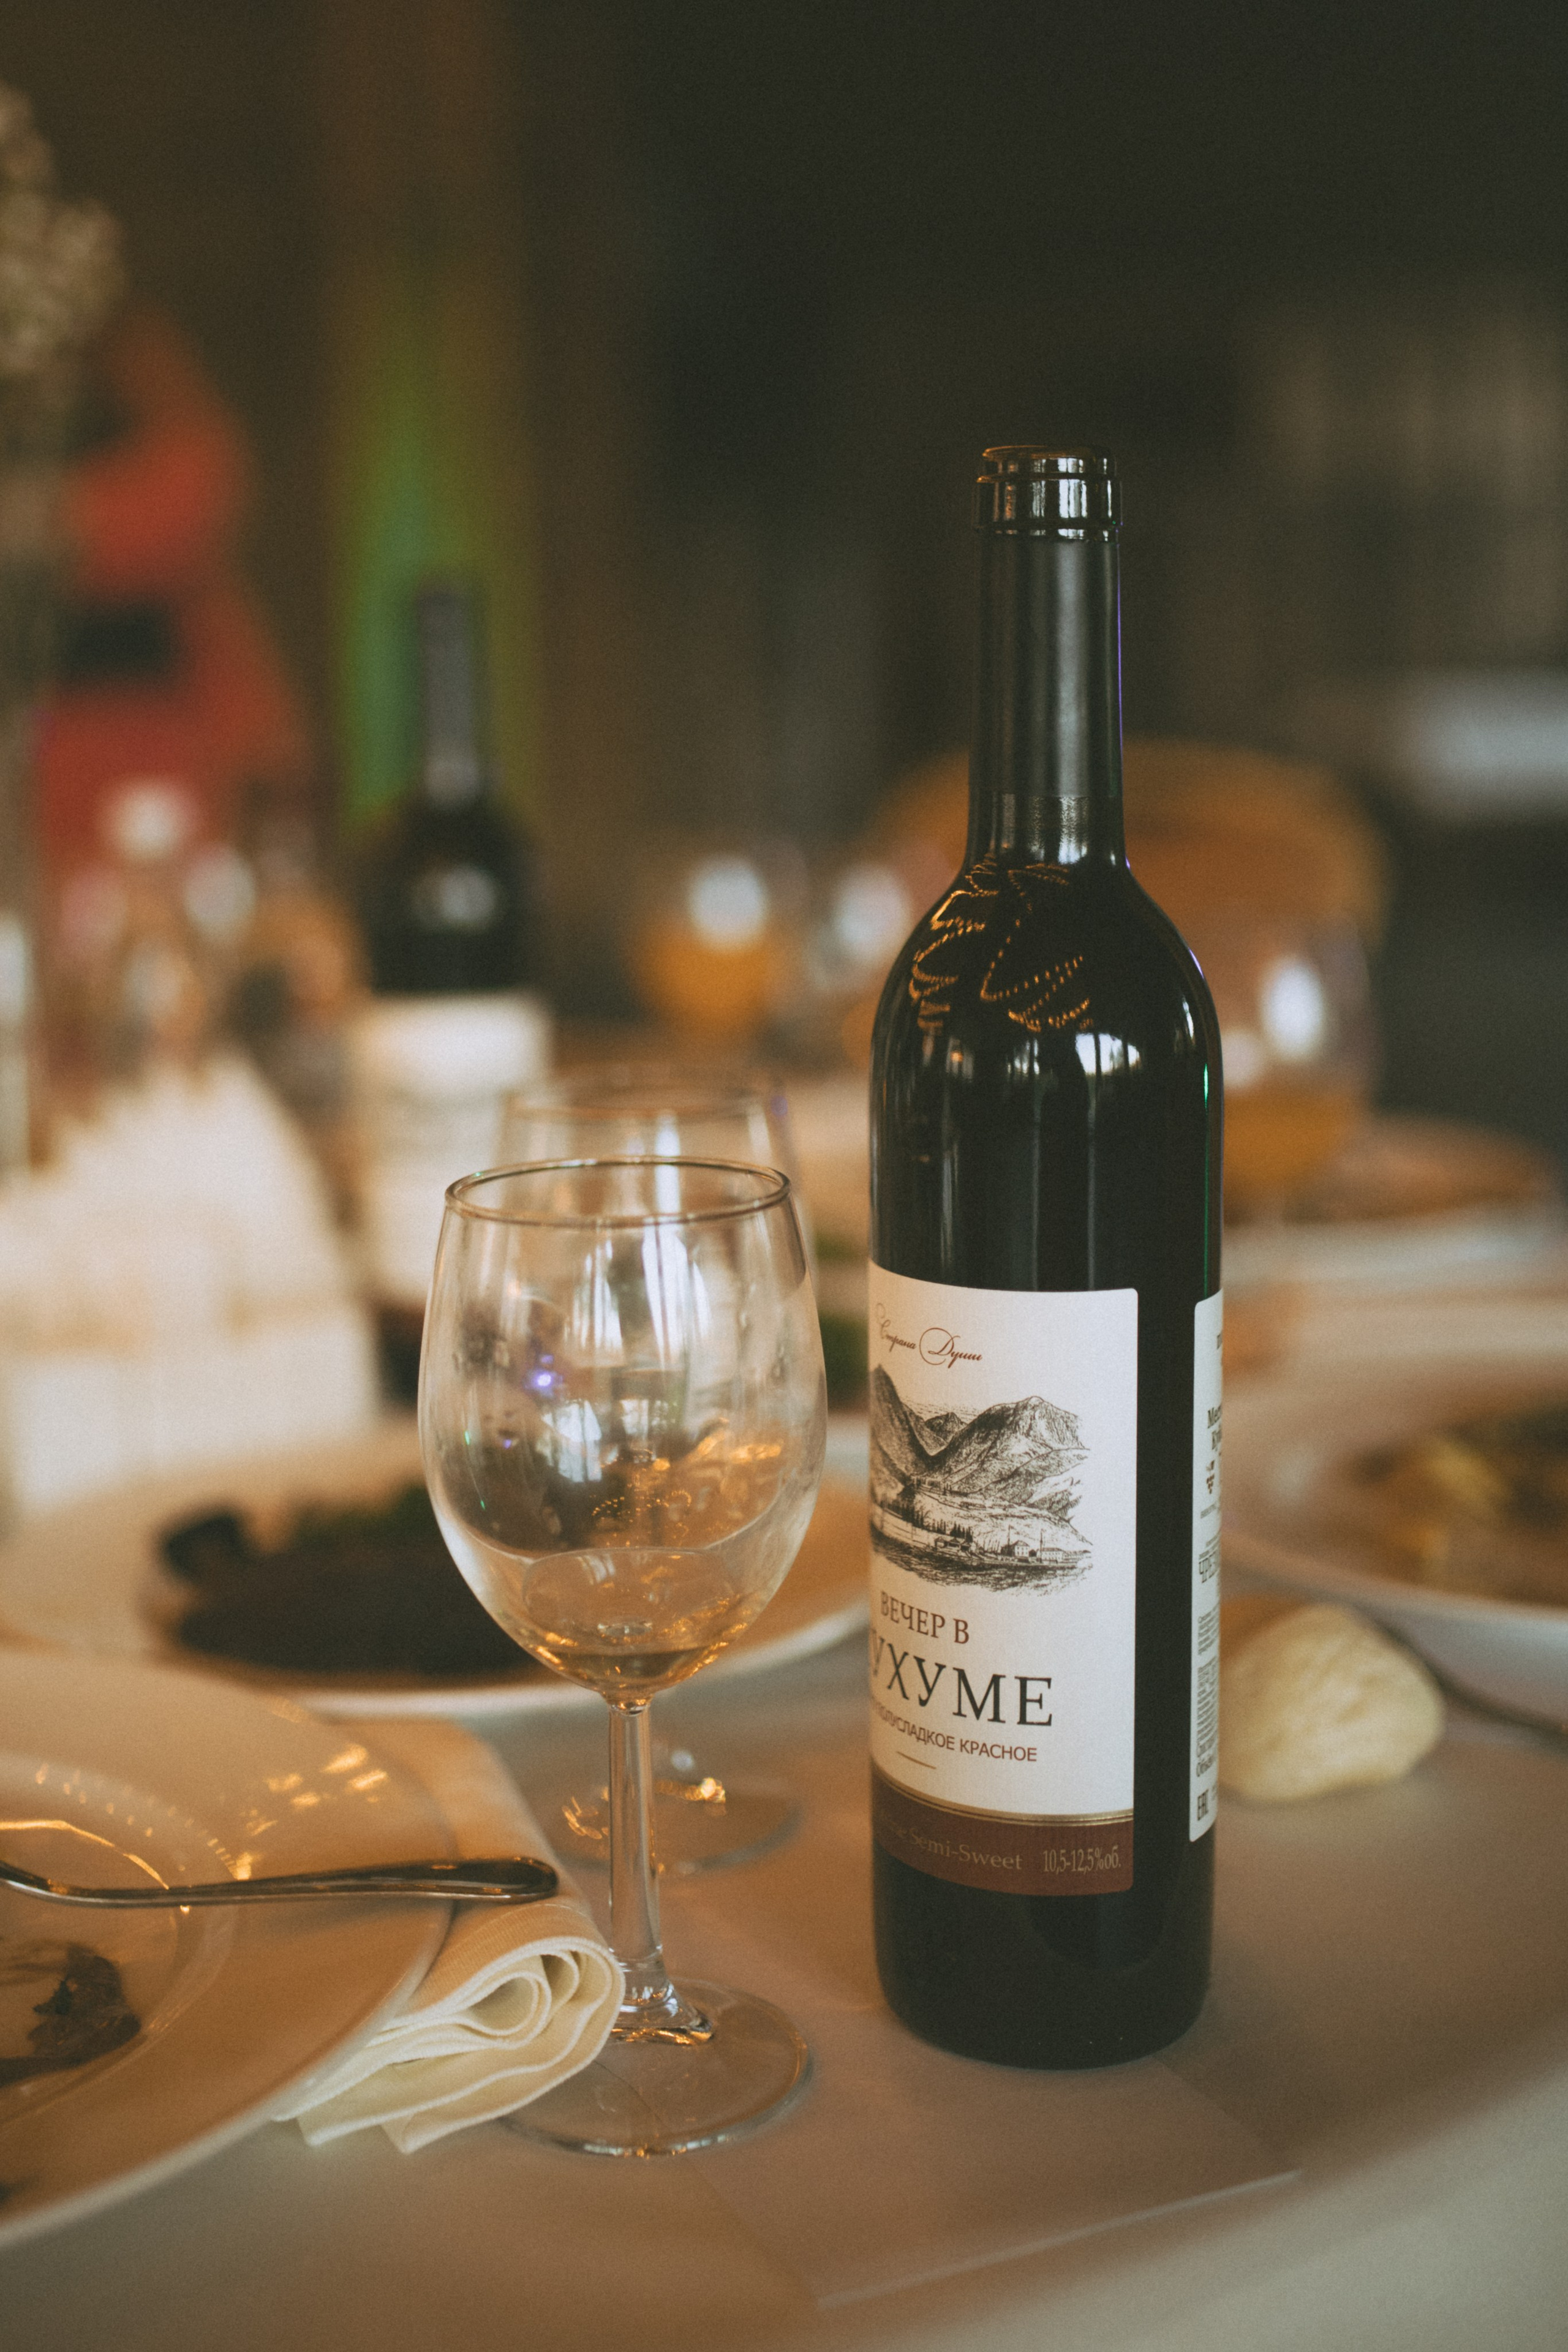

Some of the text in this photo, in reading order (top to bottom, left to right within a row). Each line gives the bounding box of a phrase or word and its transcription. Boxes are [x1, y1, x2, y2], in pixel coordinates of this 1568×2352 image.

[876, 1303, 982, 1368] Страна Души
[881, 1591, 970, 1645] ВЕЧЕР В
[870, 1627, 1053, 1727] УХУМЕ
[960, 1739, 1037, 1762] КРАСНОЕ
[908, 1827, 1023, 1871] Semi-Sweet
